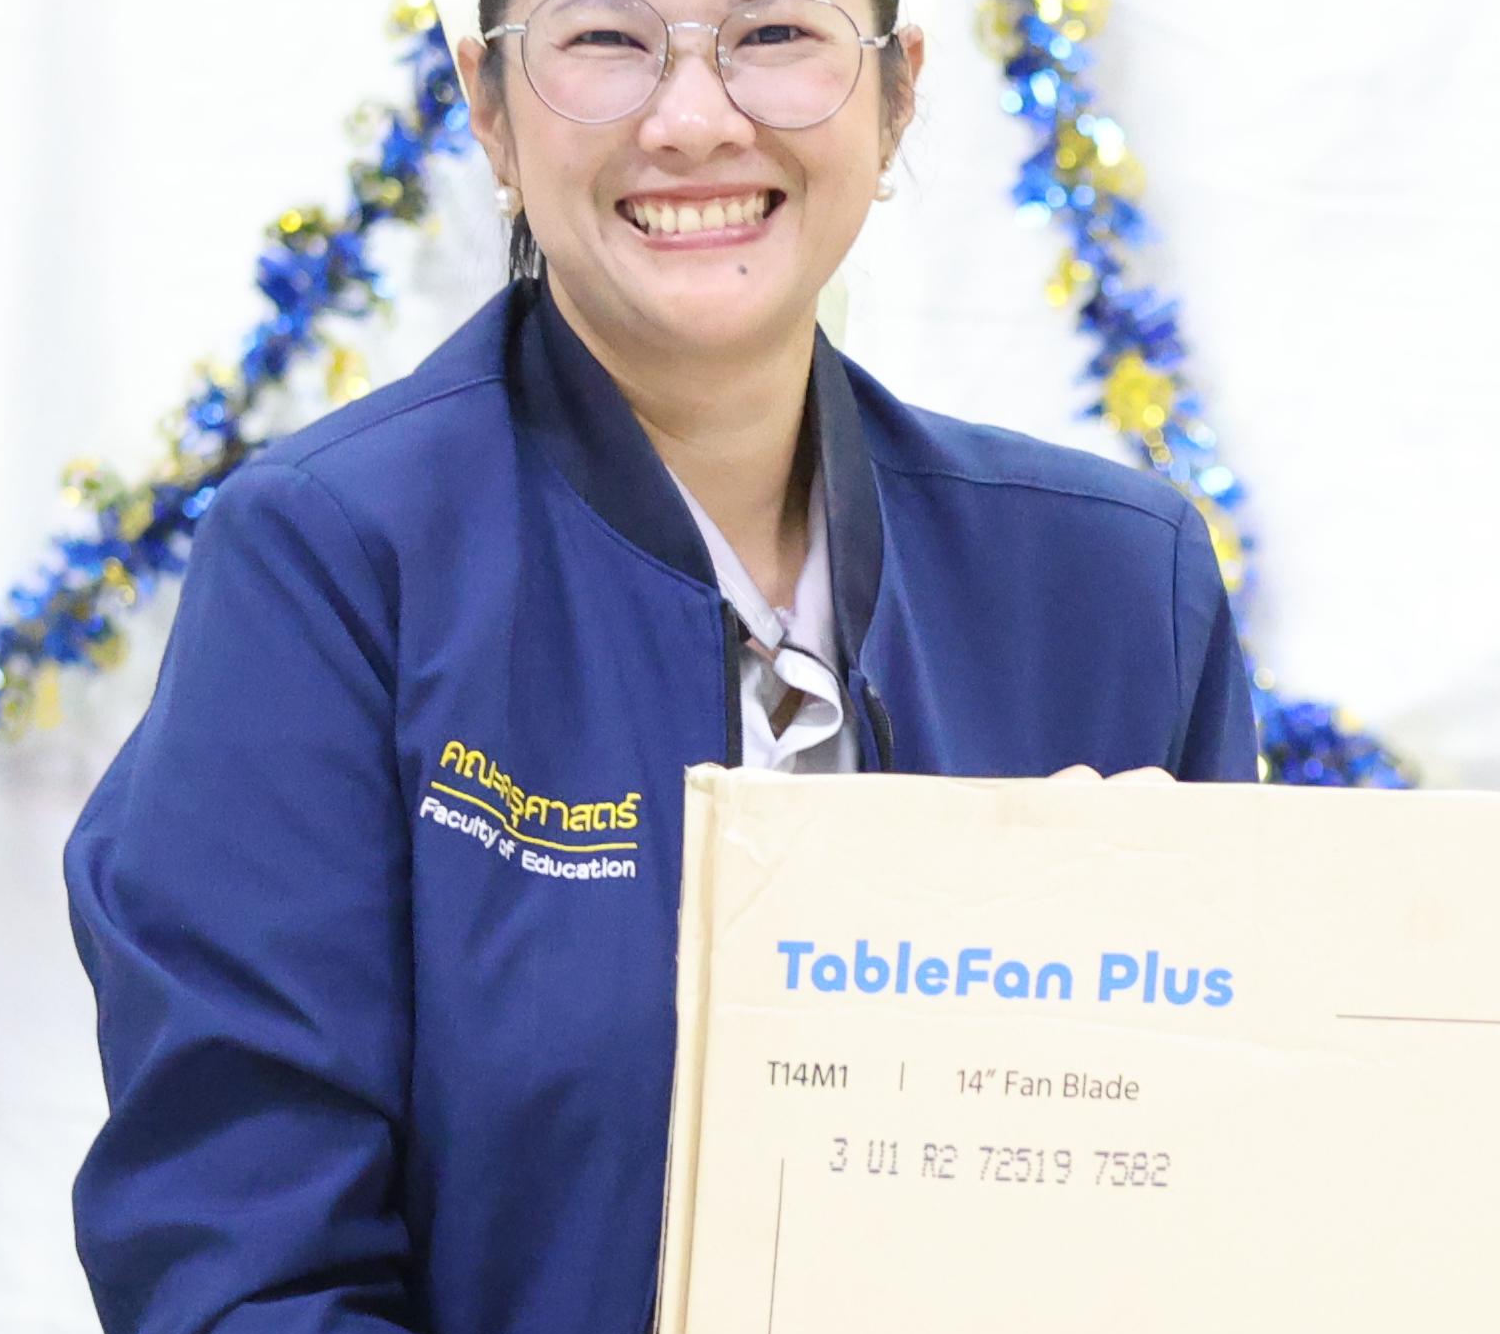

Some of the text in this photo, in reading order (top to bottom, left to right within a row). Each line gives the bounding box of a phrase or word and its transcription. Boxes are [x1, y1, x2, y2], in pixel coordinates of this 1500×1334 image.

[439, 739, 642, 830] คณะครุศาสตร์
[419, 795, 637, 880] Faculty of Education
[776, 939, 1235, 1008] TableFan Plus
[766, 1060, 849, 1089] T14M1
[1003, 1069, 1053, 1098] Fan
[1061, 1072, 1141, 1101] Blade
[979, 1146, 1073, 1184] 72519
[1093, 1151, 1171, 1187] 7582
